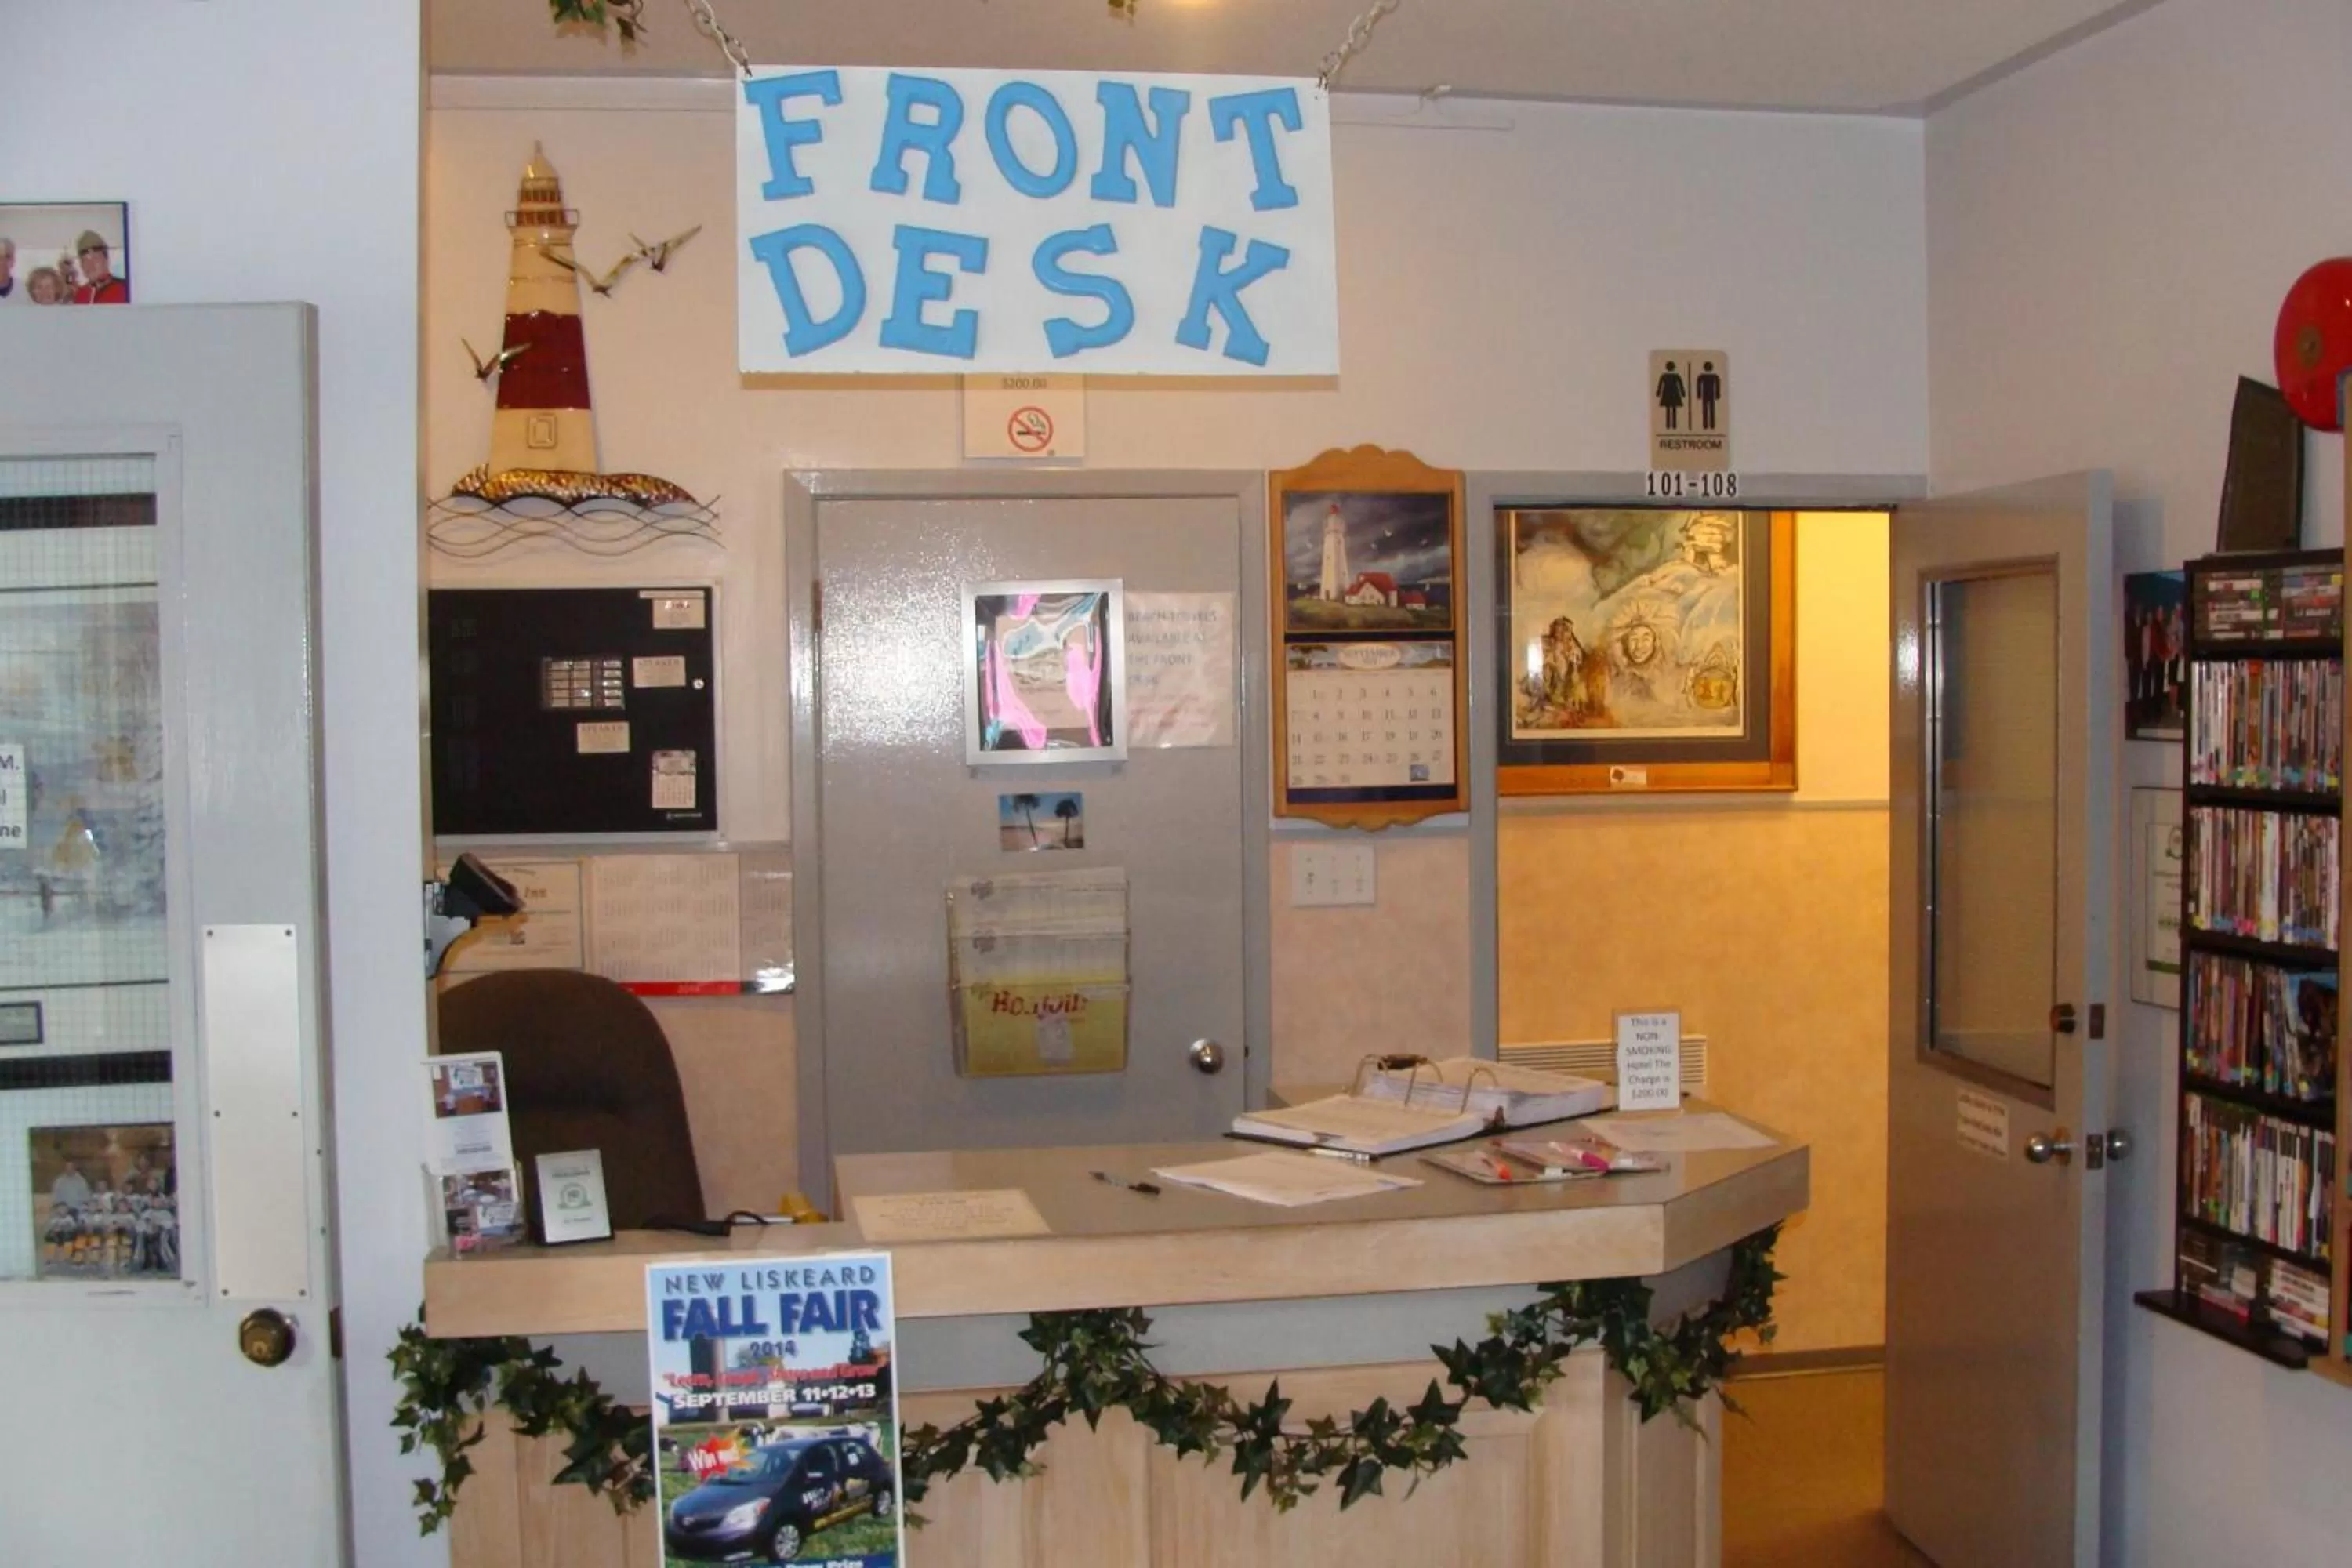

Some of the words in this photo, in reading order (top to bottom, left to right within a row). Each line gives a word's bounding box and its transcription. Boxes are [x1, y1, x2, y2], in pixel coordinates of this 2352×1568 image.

[744, 69, 1303, 212] FRONT
[750, 223, 1290, 367] DESK
[1658, 438, 1722, 451] RESTROOM
[1647, 471, 1738, 498] 101-108
[1630, 1017, 1649, 1027] This
[1625, 1045, 1672, 1056] SMOKING
[1655, 1059, 1672, 1069] The
[665, 1272, 725, 1294] NEW
[740, 1265, 877, 1290] LISKEARD
[662, 1294, 769, 1341] FALL
[779, 1288, 883, 1336] FAIR
[748, 1339, 797, 1358] 2014
[673, 1386, 797, 1410] SEPTEMBER
[686, 1446, 719, 1472] Win
